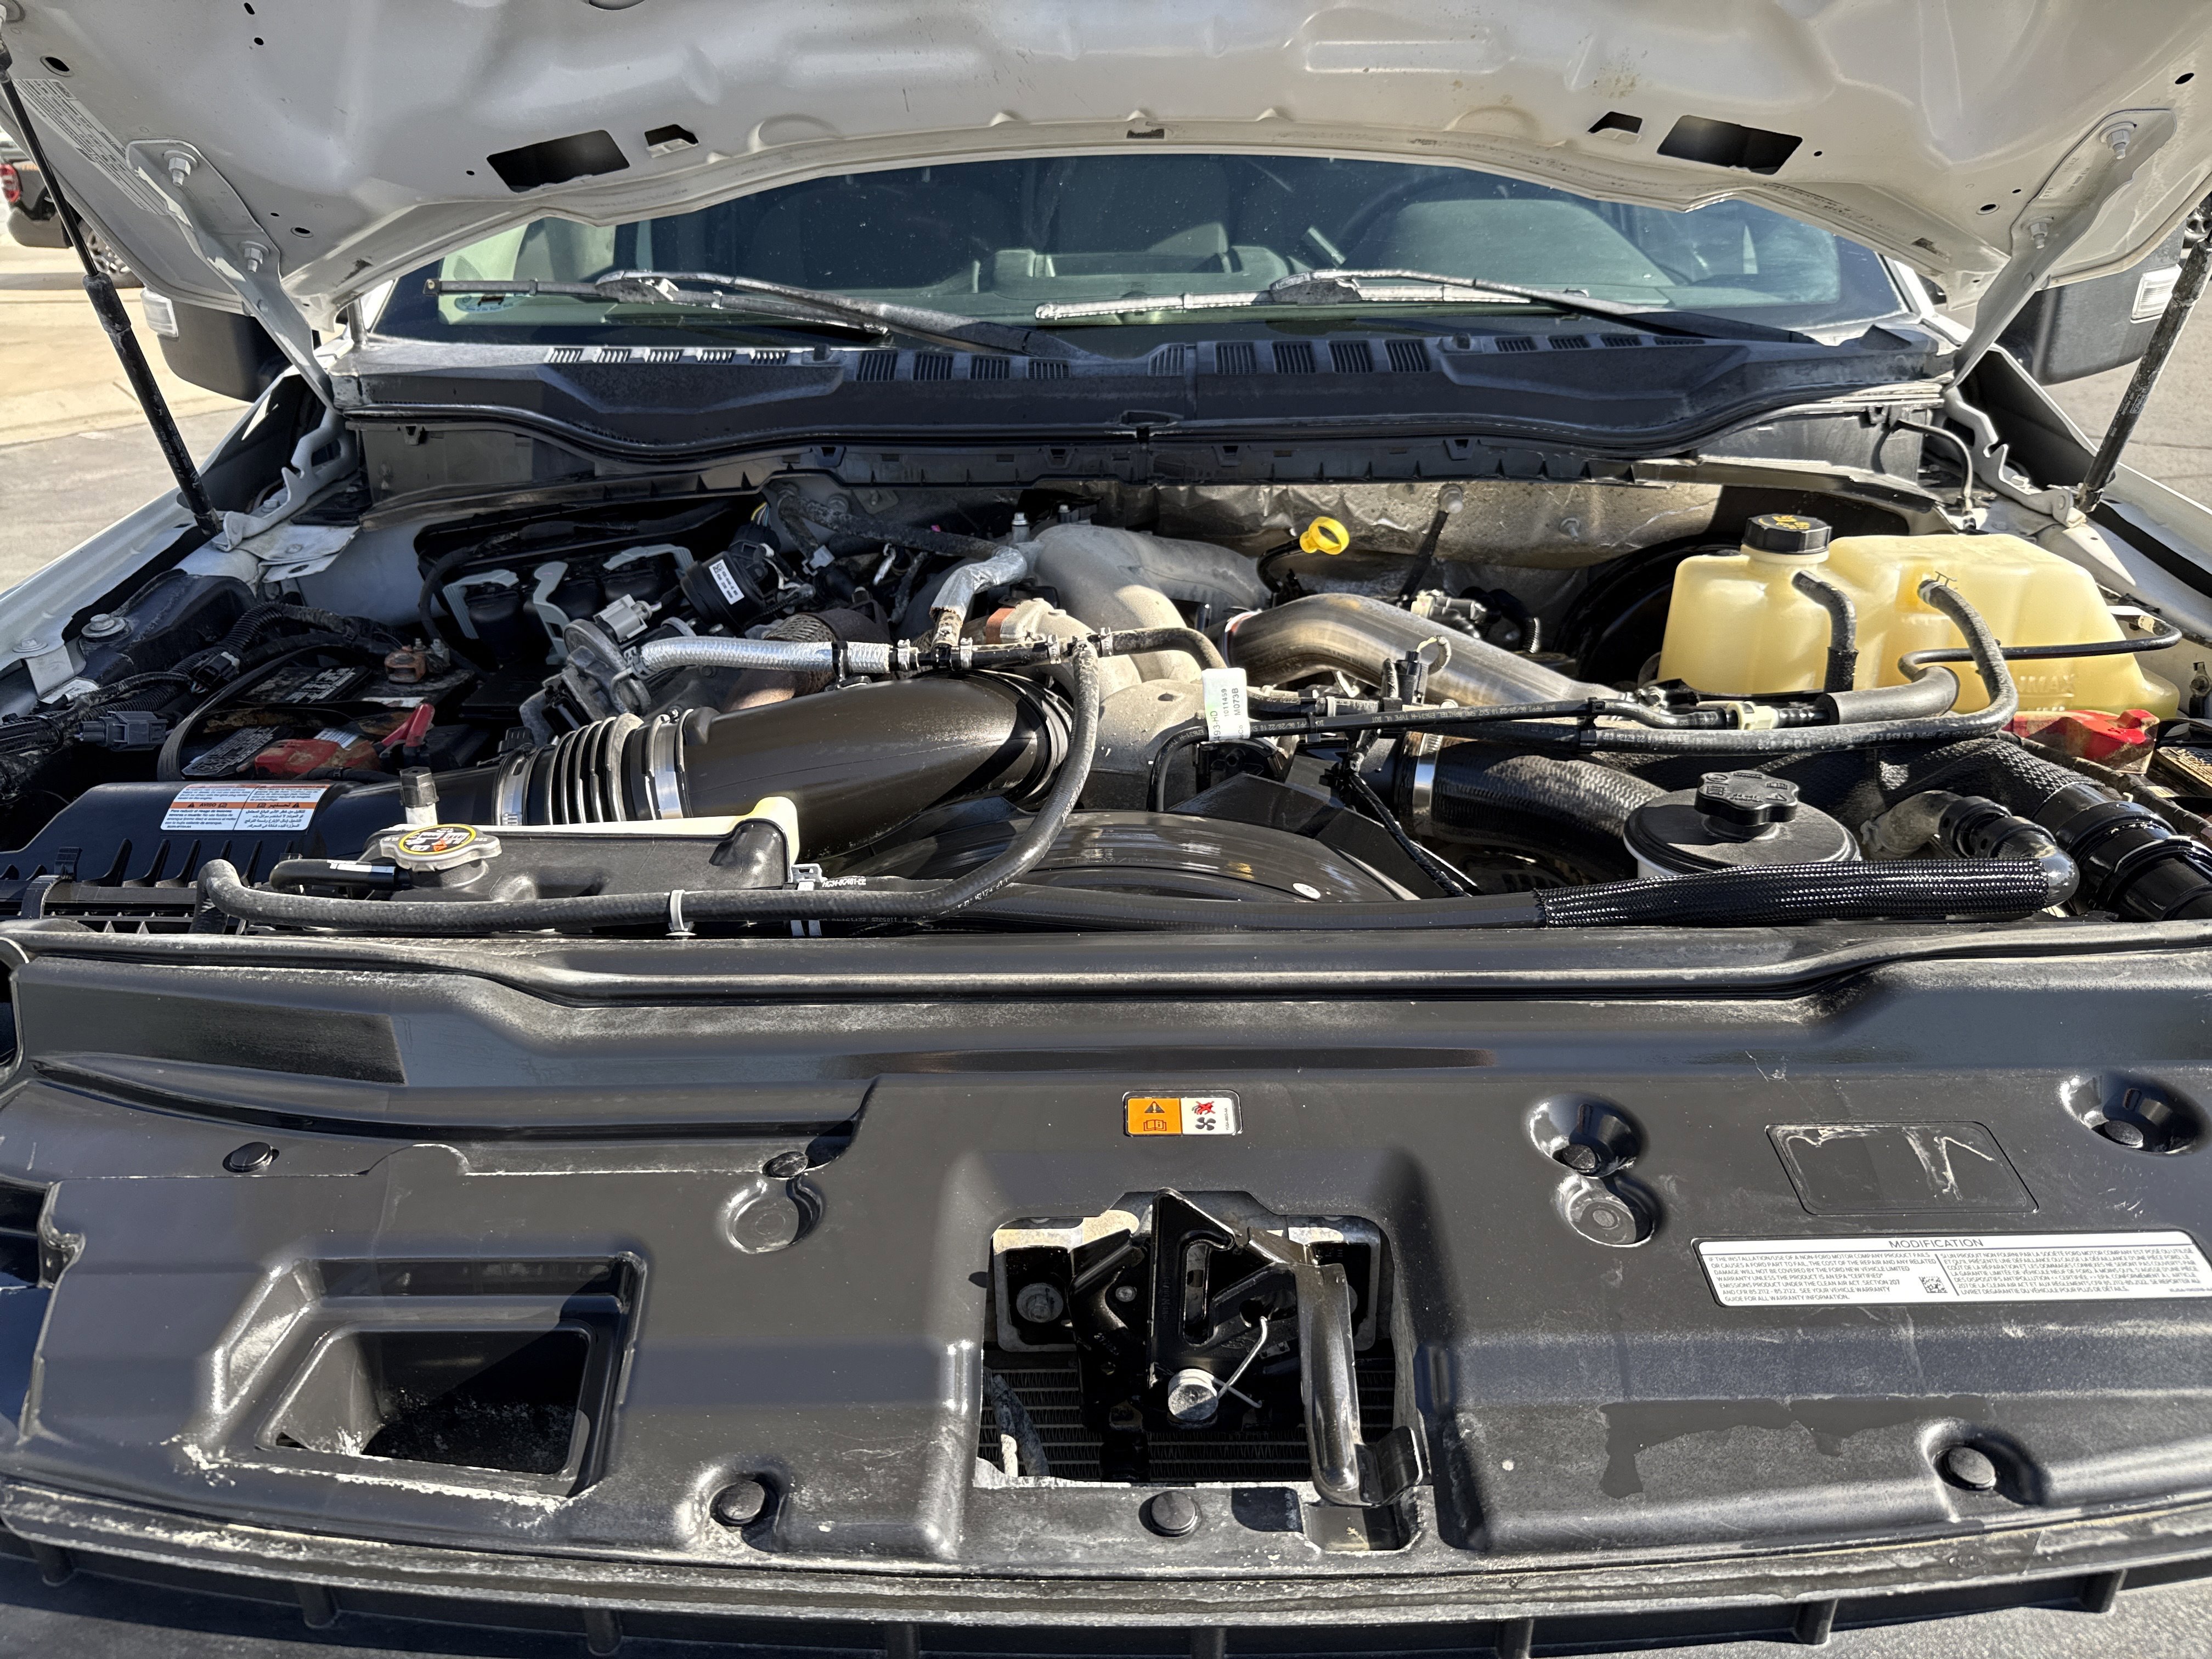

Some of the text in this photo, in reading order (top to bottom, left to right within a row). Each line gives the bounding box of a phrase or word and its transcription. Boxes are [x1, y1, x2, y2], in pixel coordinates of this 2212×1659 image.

[1221, 689, 1229, 716] 1011459
[1232, 688, 1241, 715] M073B
[1889, 1239, 1983, 1248] MODIFICATION
